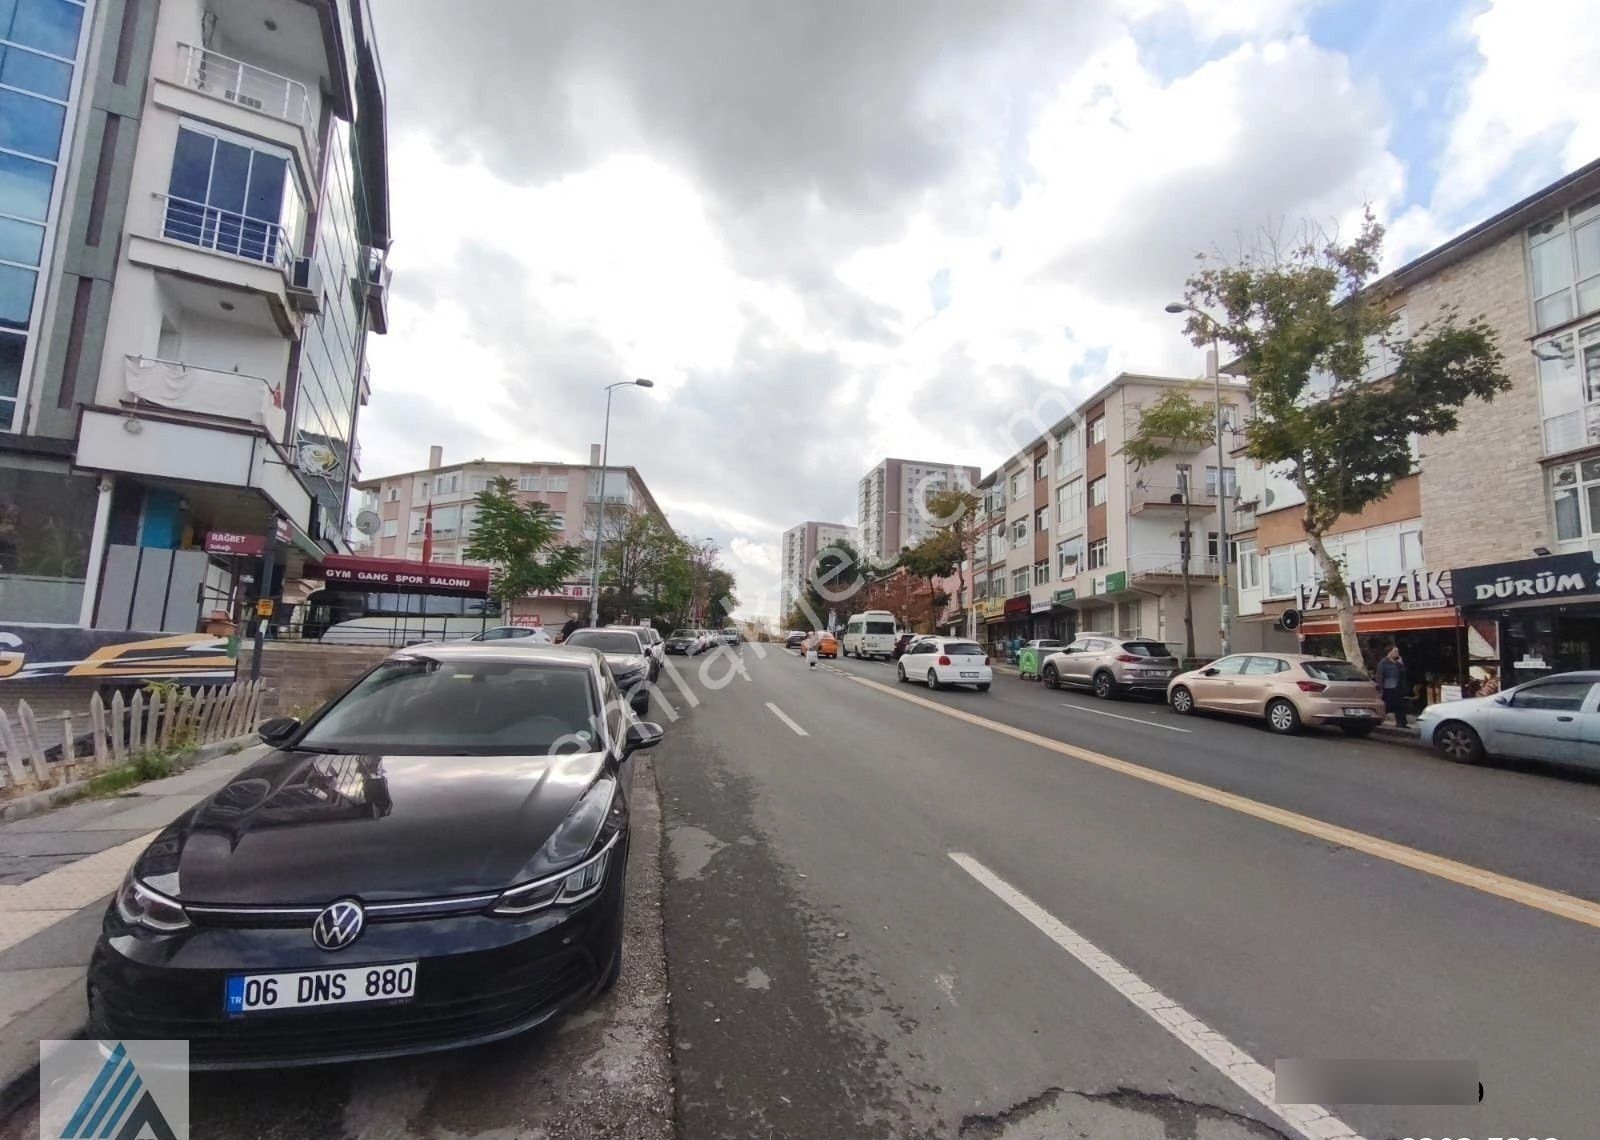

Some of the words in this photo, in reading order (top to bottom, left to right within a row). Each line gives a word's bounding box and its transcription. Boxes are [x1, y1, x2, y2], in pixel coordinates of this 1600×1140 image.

[211, 533, 247, 543] RAĞBET
[326, 569, 351, 578] GYM
[358, 571, 389, 581] GANG
[395, 574, 424, 584] SPOR
[429, 577, 470, 587] SALONU
[1475, 571, 1586, 600] DÜRÜM
[245, 978, 278, 1007] 06
[297, 973, 347, 1003] DNS
[365, 967, 413, 997] 880
[230, 996, 242, 1004] TR
